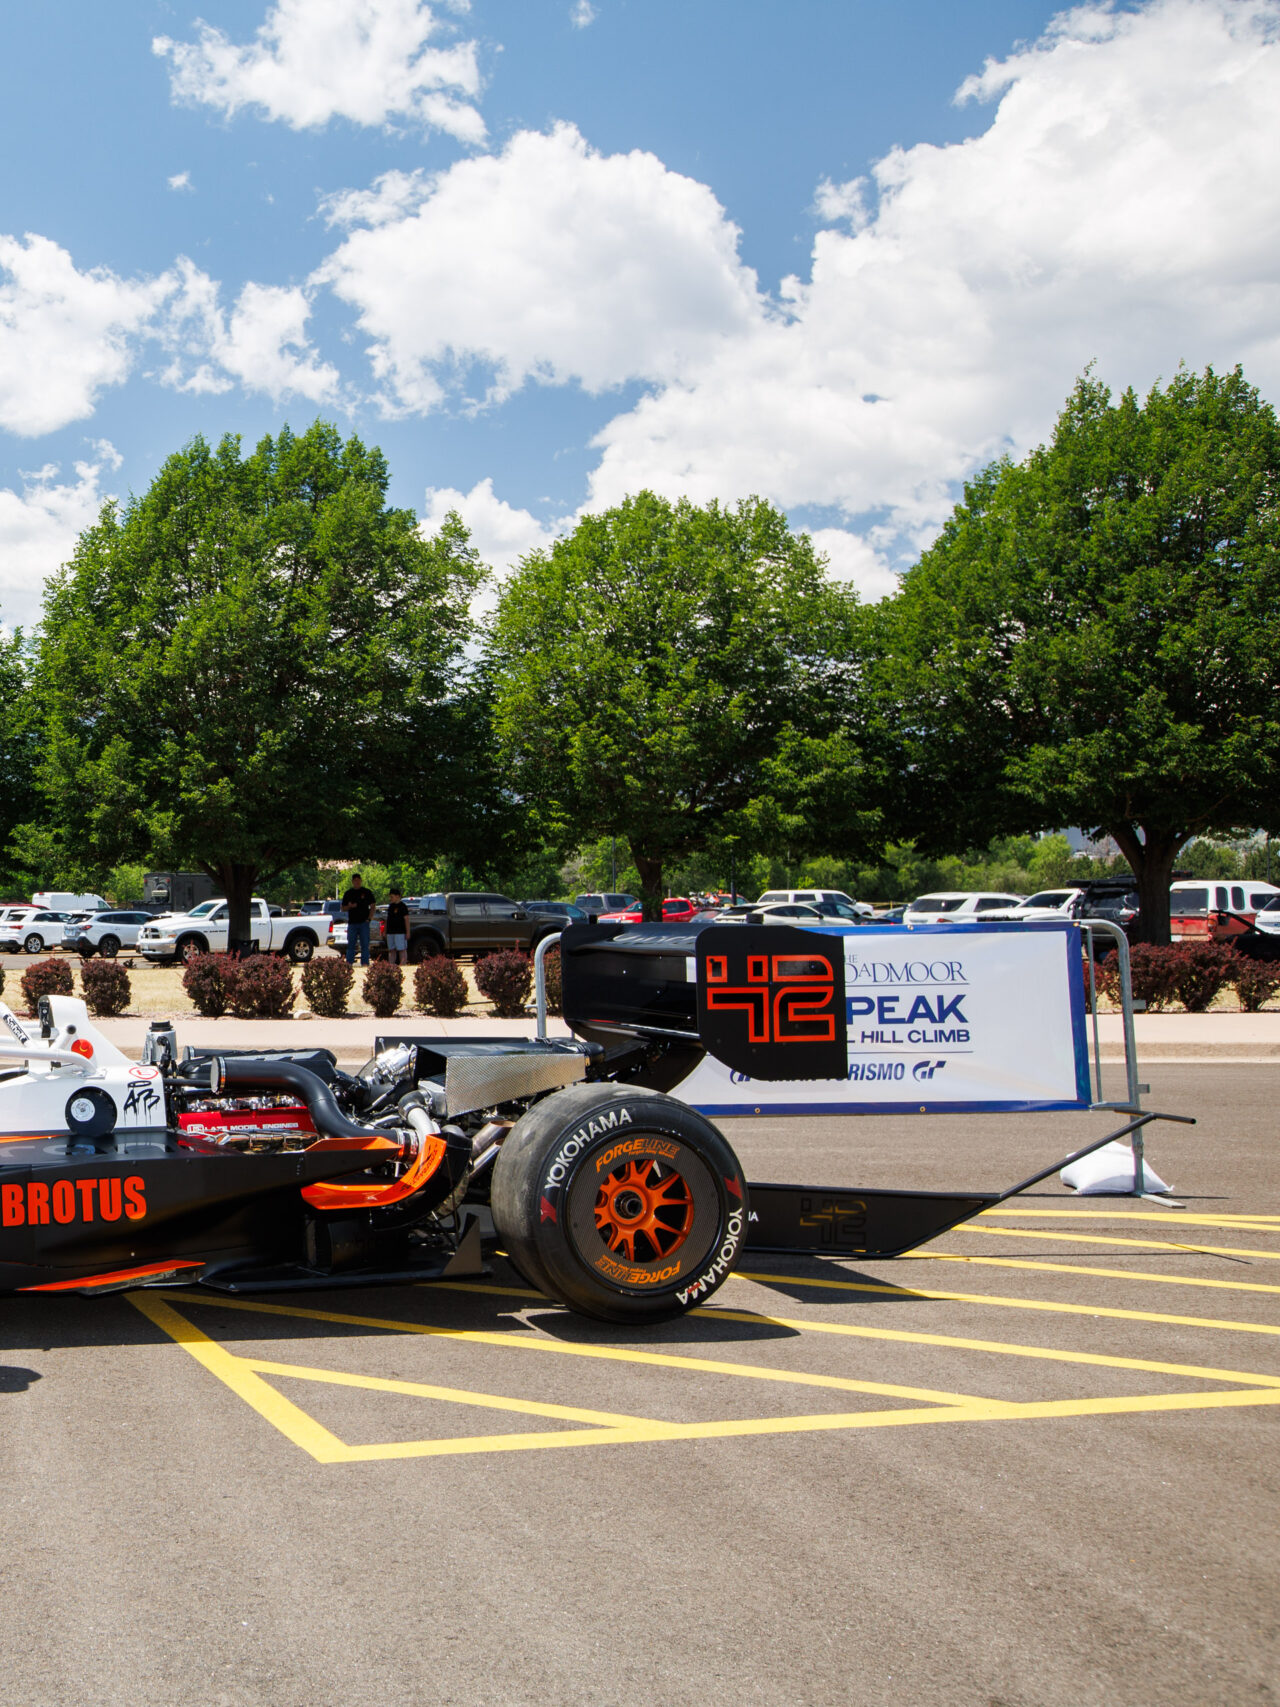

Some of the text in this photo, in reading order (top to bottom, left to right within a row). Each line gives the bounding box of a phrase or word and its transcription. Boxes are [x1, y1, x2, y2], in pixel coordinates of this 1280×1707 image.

[845, 961, 968, 983] OADMOOR
[703, 954, 836, 1043] 42
[846, 994, 969, 1025] PEAK
[861, 1031, 904, 1043] HILL
[907, 1029, 970, 1042] CLIMB
[848, 1062, 905, 1081] RISMO
[544, 1108, 632, 1189] YOKOHAMA
[595, 1139, 680, 1173] FORGELINE
[1, 1176, 148, 1227] BROTUS
[594, 1257, 681, 1284] FORGELINE
[676, 1207, 742, 1305] YOKOHAMA
